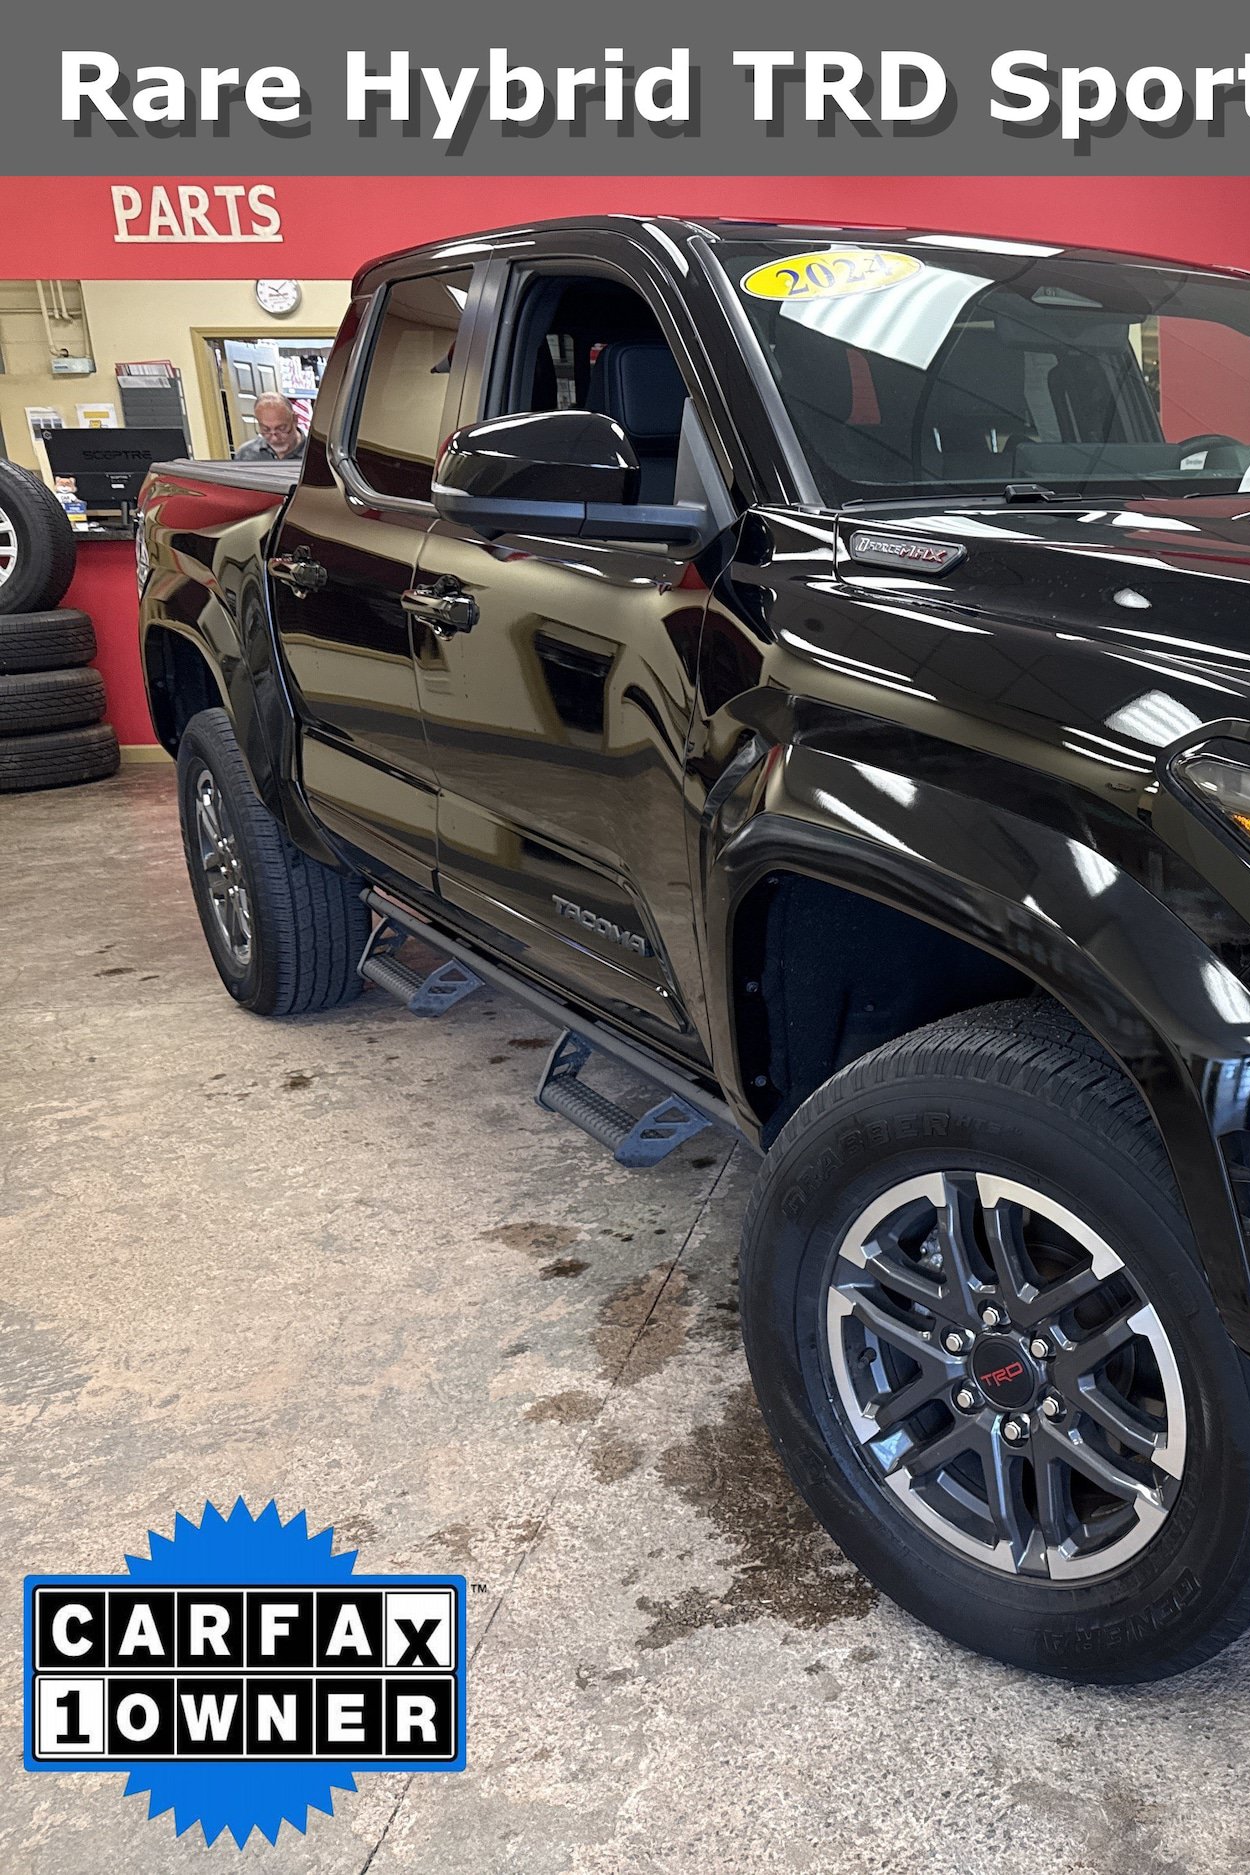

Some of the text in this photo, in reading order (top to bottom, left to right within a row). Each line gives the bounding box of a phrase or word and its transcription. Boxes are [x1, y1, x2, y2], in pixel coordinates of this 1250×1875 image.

[110, 184, 281, 237] PARTS
[775, 253, 893, 296] 2024
[82, 449, 152, 460] SCEPTRE
[551, 894, 646, 957] TACOMA
[980, 1361, 1024, 1387] TRD
